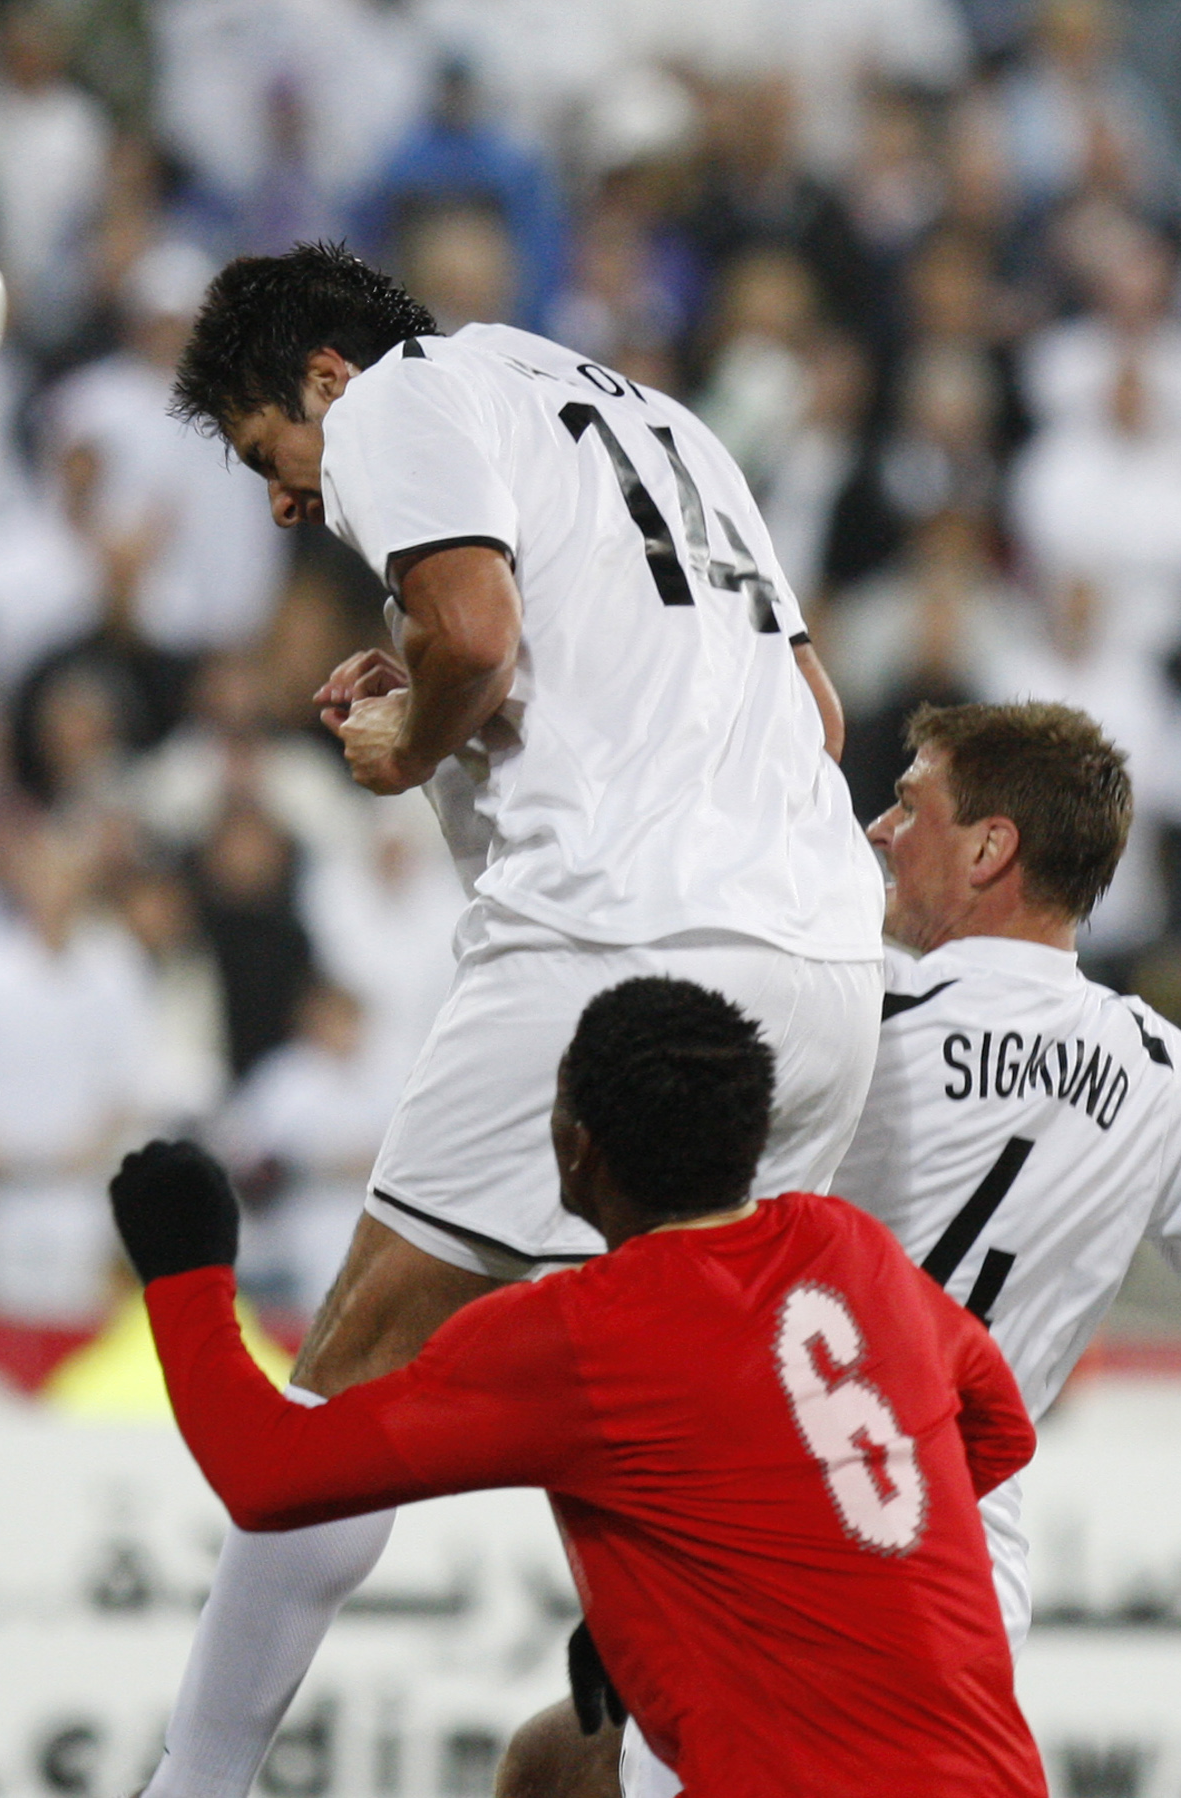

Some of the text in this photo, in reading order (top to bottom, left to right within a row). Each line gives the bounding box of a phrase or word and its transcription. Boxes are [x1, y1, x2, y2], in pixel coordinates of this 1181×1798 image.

[558, 402, 781, 634] 14
[943, 1030, 1130, 1132] SIGMUND
[773, 1279, 930, 1558] 6
